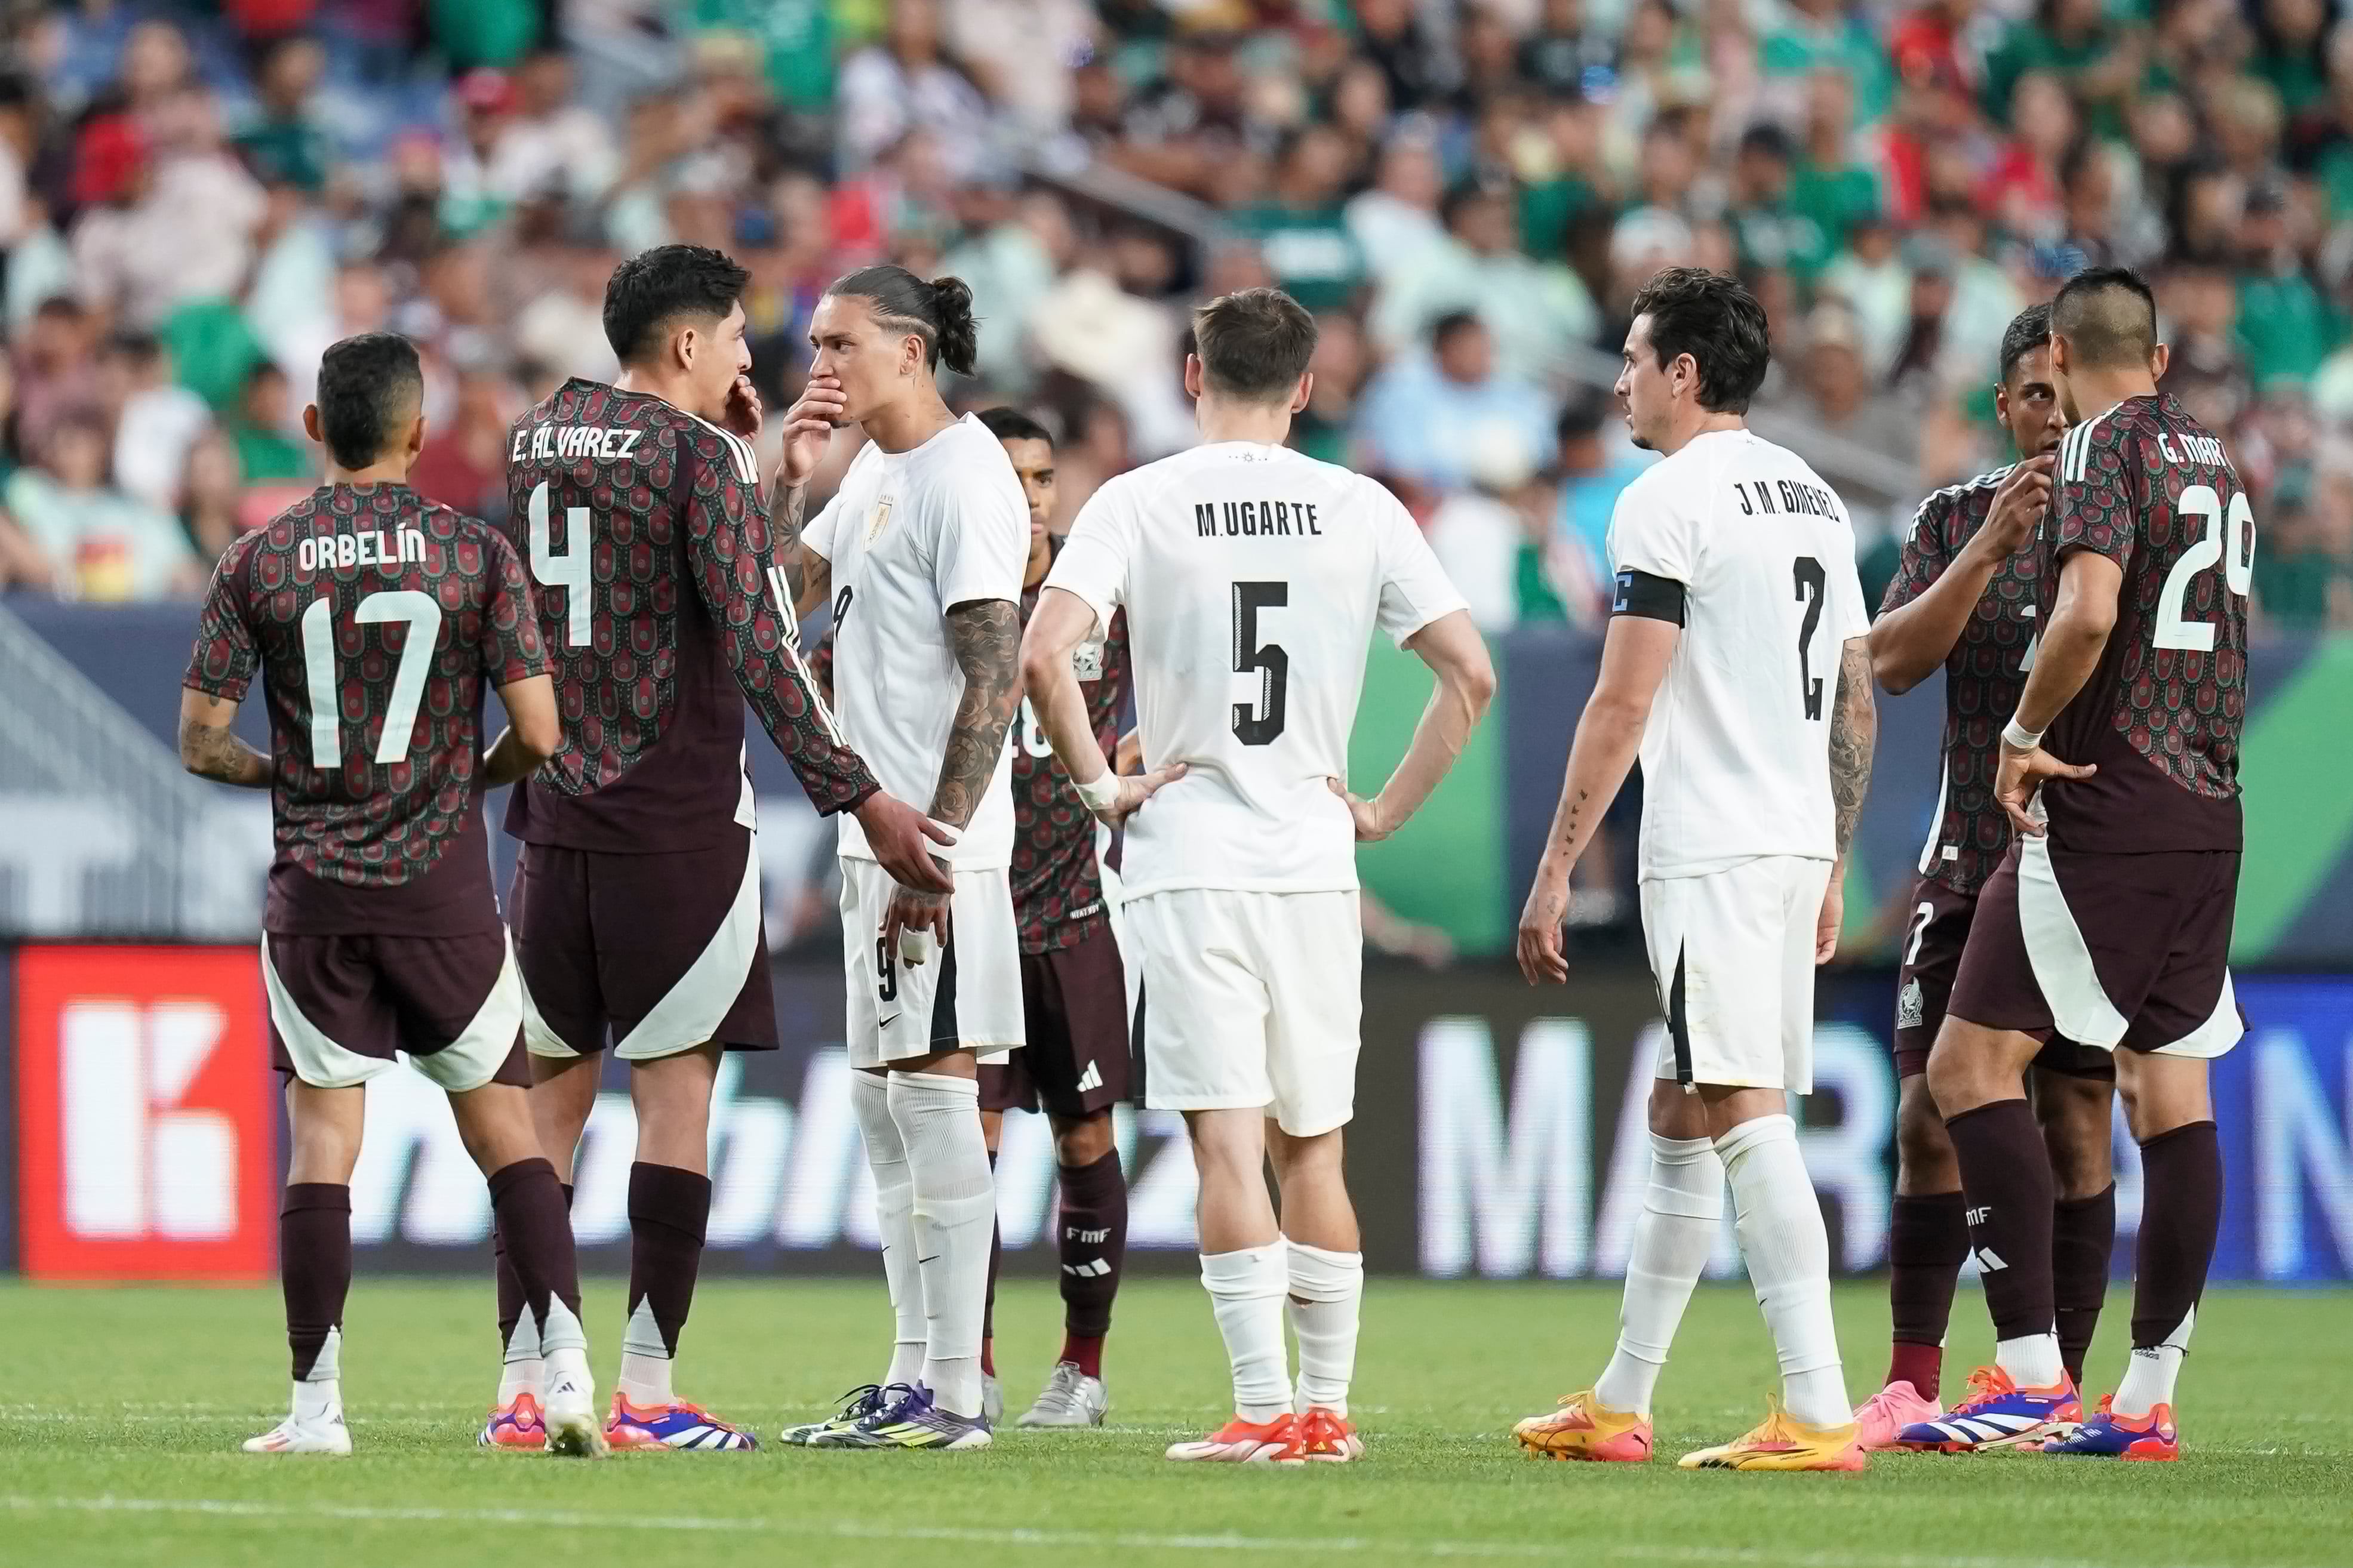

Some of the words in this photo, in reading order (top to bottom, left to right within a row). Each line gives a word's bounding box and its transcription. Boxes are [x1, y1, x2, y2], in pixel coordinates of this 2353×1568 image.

[528, 480, 592, 646] 4
[1793, 556, 1826, 721] 2
[2152, 485, 2257, 652] 29
[302, 590, 442, 769] 17
[1232, 581, 1288, 746] 5
[876, 937, 897, 1002] 9
